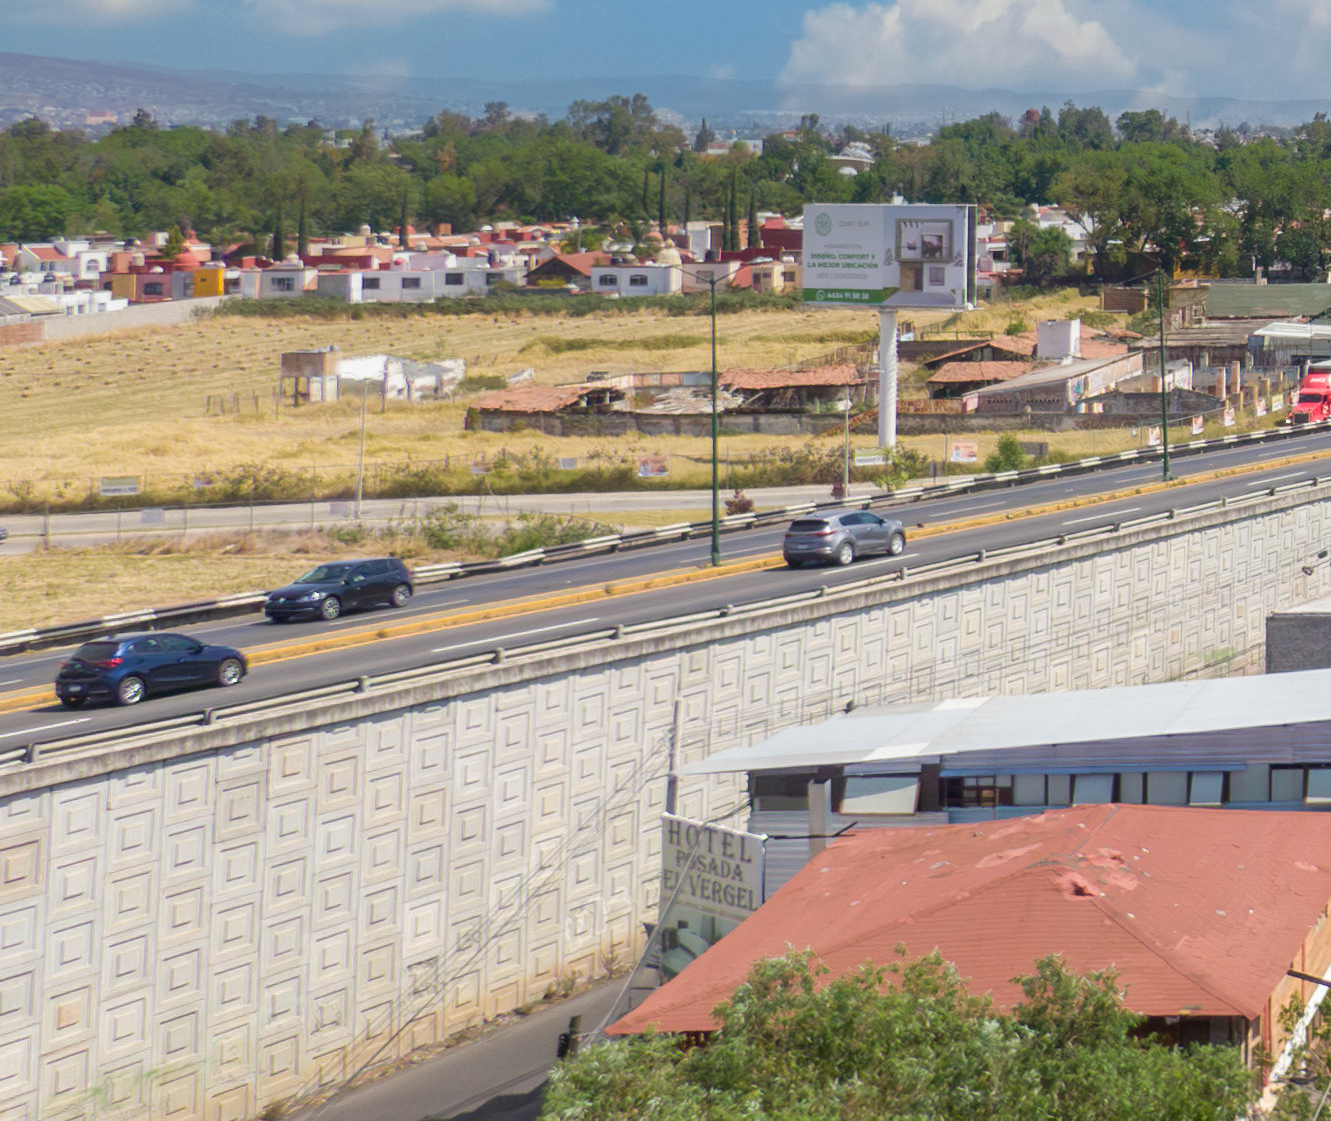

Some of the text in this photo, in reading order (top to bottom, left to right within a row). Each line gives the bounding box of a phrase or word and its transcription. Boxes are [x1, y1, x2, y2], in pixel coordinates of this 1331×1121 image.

[668, 820, 752, 863] HOTEL
[675, 849, 743, 882] POSADA
[689, 874, 758, 912] VERGEL
